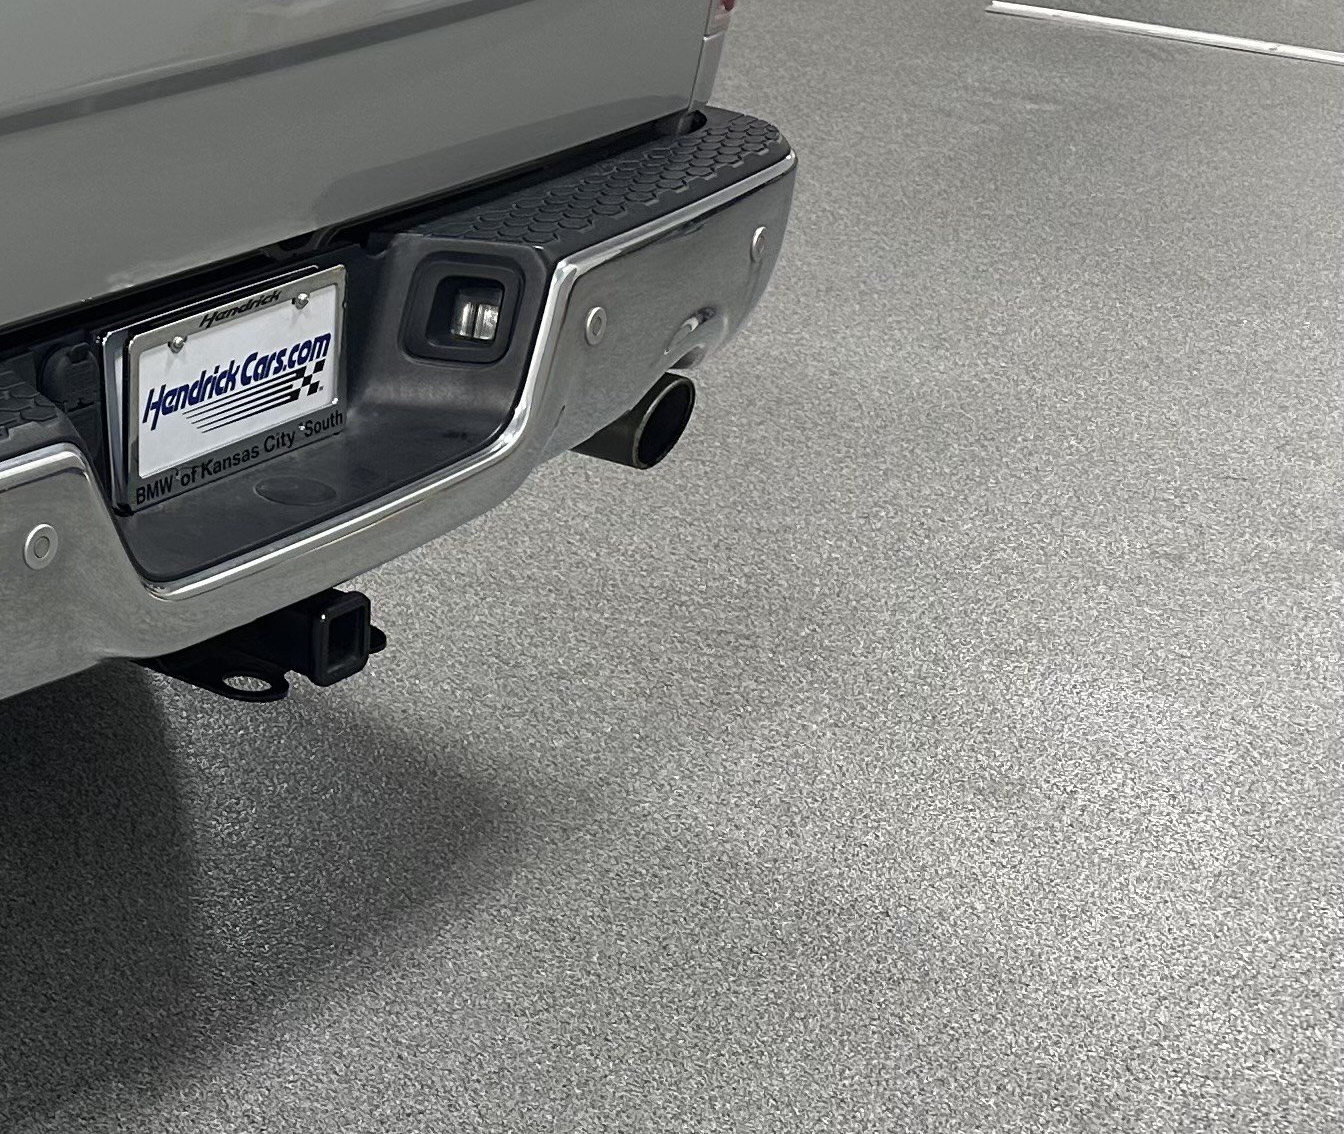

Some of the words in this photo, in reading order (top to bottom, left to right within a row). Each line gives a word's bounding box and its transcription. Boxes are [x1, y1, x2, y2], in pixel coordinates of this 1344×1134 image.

[198, 290, 282, 328] Hendrick
[142, 332, 332, 431] HendrickCars.com
[135, 472, 174, 505] BMW
[180, 468, 198, 487] of
[201, 444, 260, 479] Kansas
[263, 431, 297, 453] City
[303, 410, 344, 439] South
